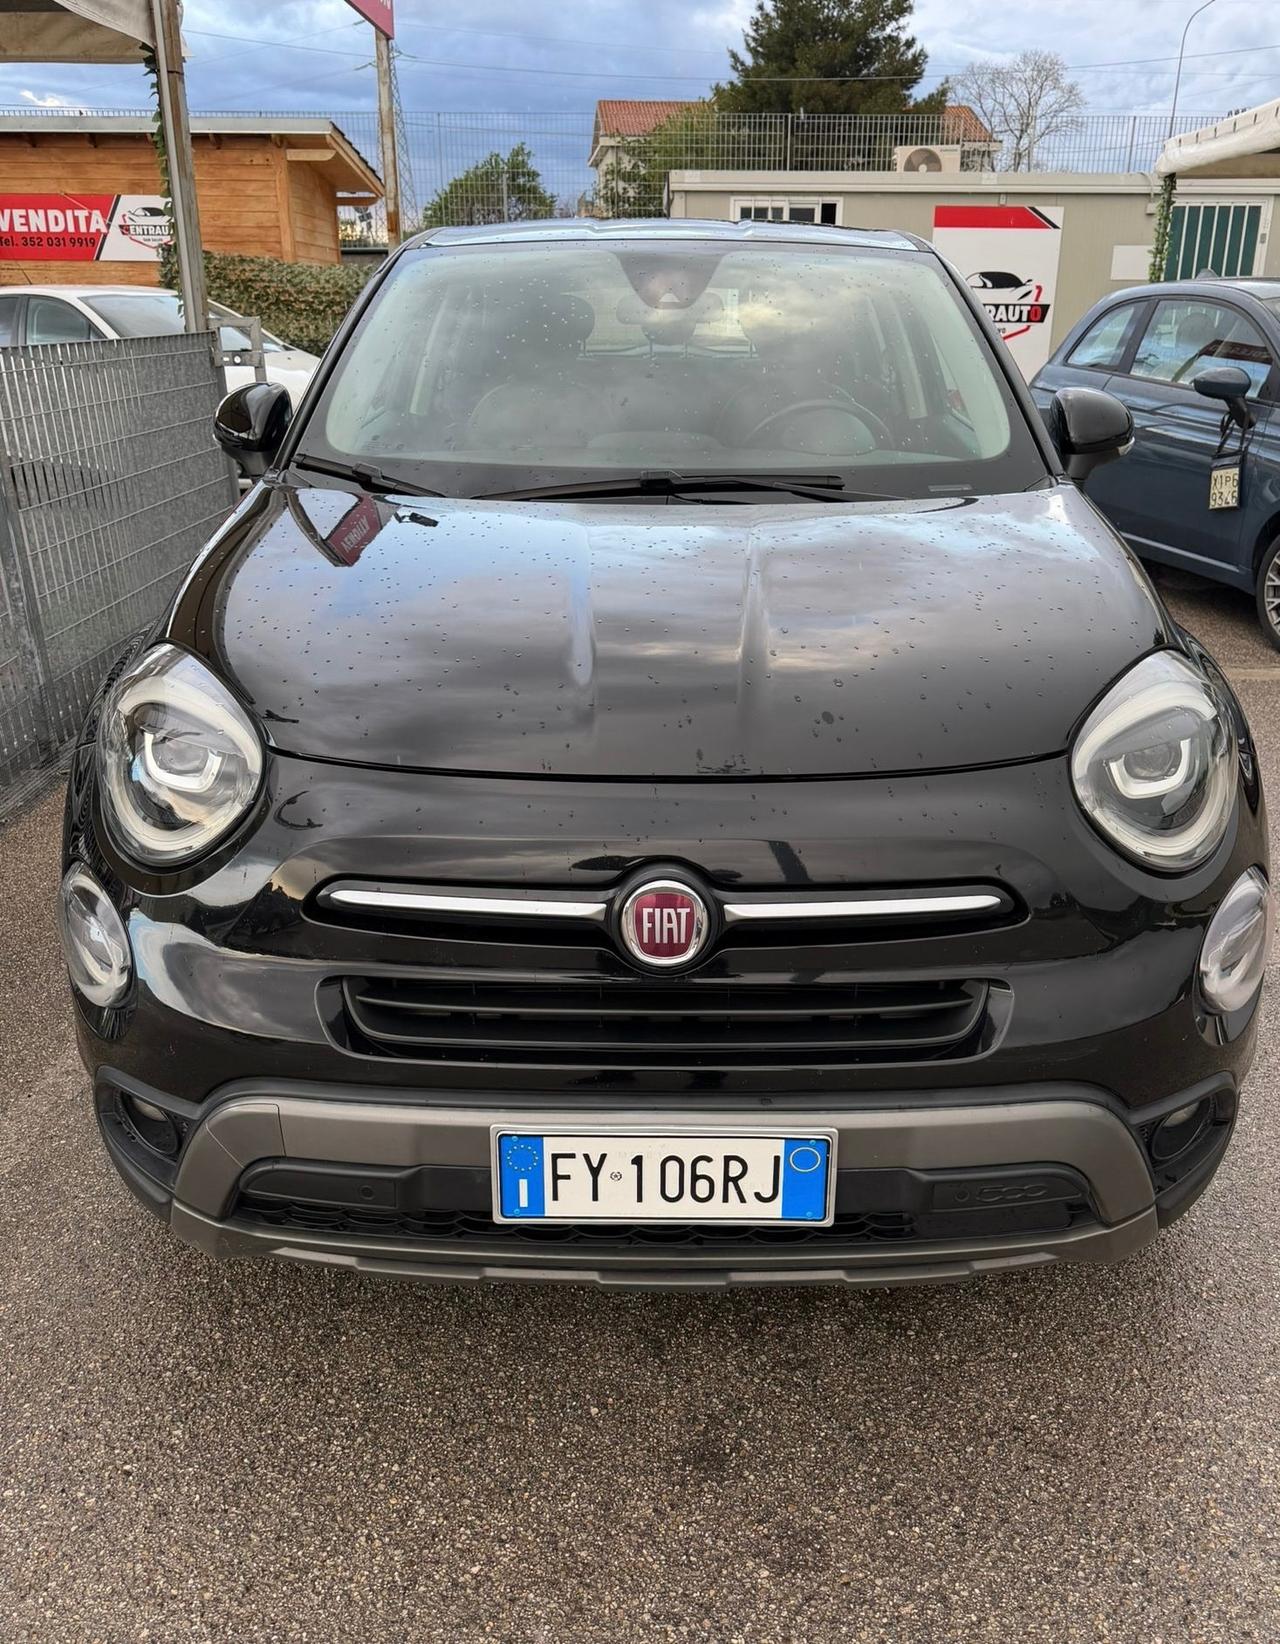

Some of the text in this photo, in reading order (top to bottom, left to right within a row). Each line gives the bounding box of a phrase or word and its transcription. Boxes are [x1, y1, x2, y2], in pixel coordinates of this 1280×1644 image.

[0, 209, 108, 233] VENDITA
[122, 225, 174, 236] CENTRAU
[22, 237, 43, 247] 352
[47, 237, 65, 247] 031
[69, 237, 95, 248] 9919
[642, 907, 691, 944] FIAT
